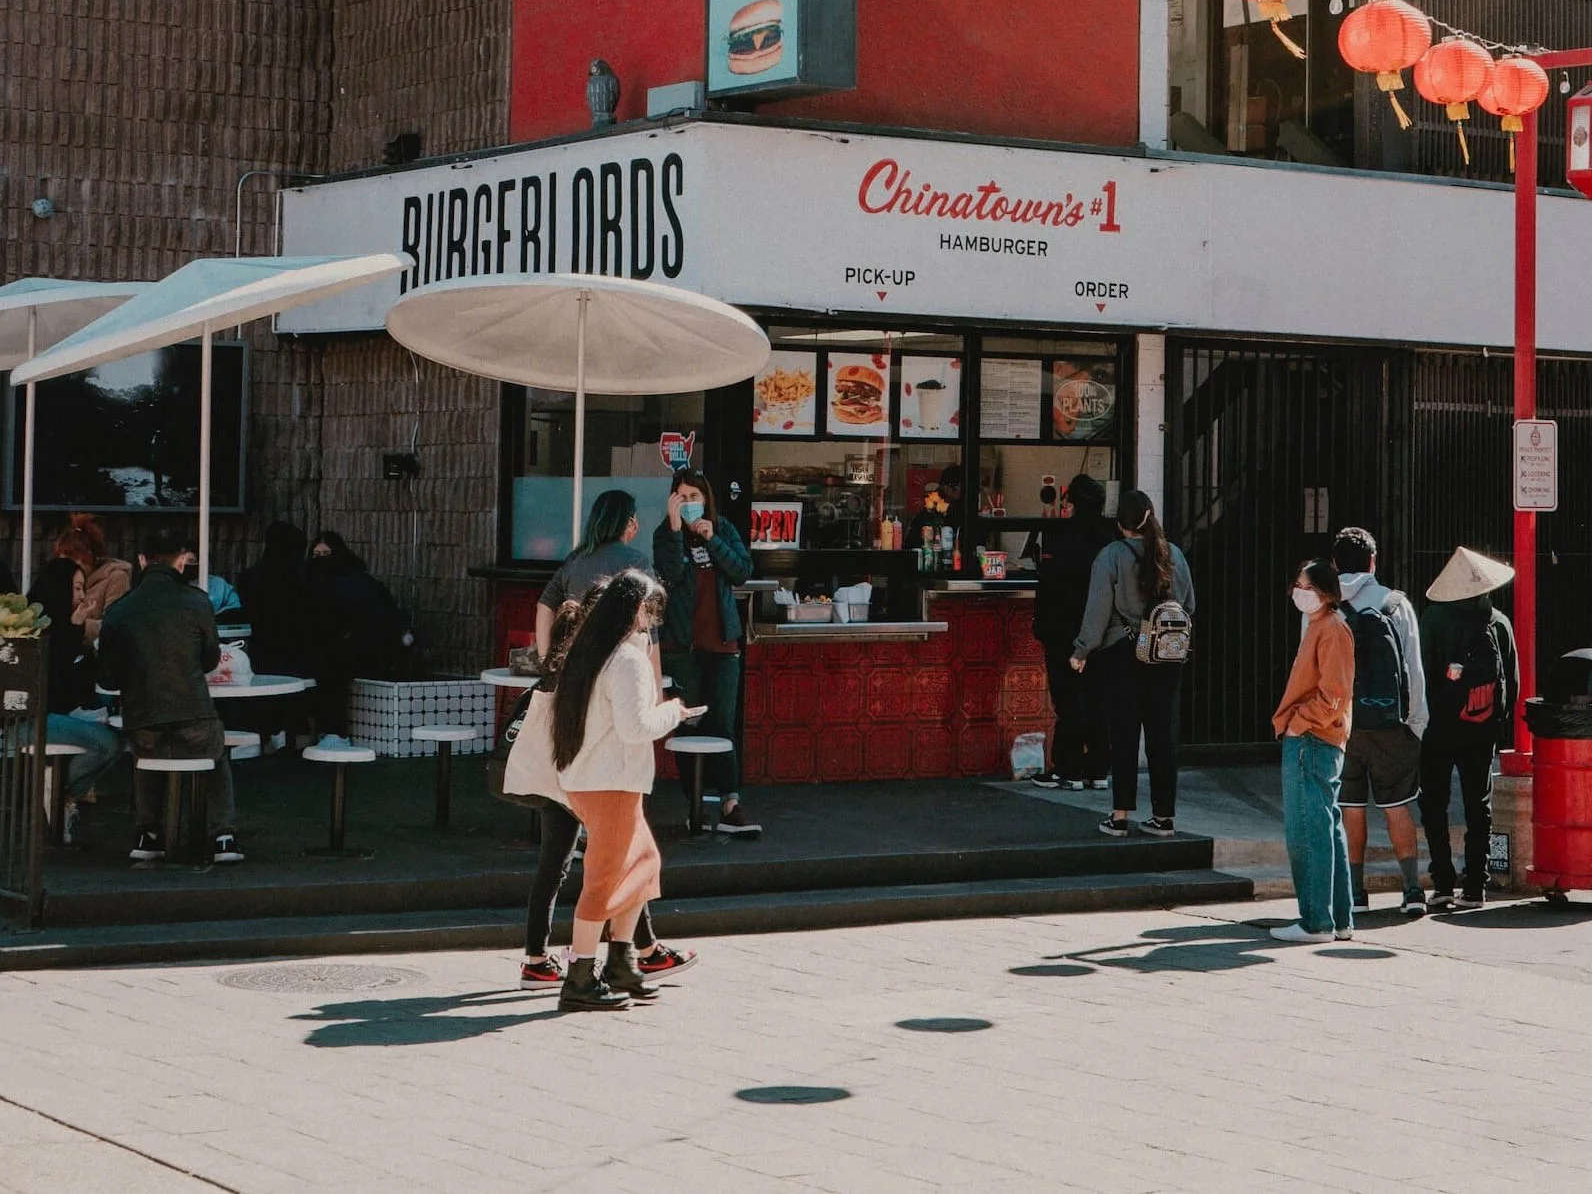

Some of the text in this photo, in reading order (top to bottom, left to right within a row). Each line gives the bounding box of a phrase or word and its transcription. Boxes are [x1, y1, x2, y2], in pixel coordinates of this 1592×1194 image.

[858, 158, 1121, 233] Chinatown's #1
[940, 234, 1048, 257] HAMBURGER
[845, 267, 915, 287] PICK-UP
[1074, 281, 1129, 299] ORDER
[1062, 398, 1105, 414] PLANTS
[987, 566, 1003, 574] JAR
